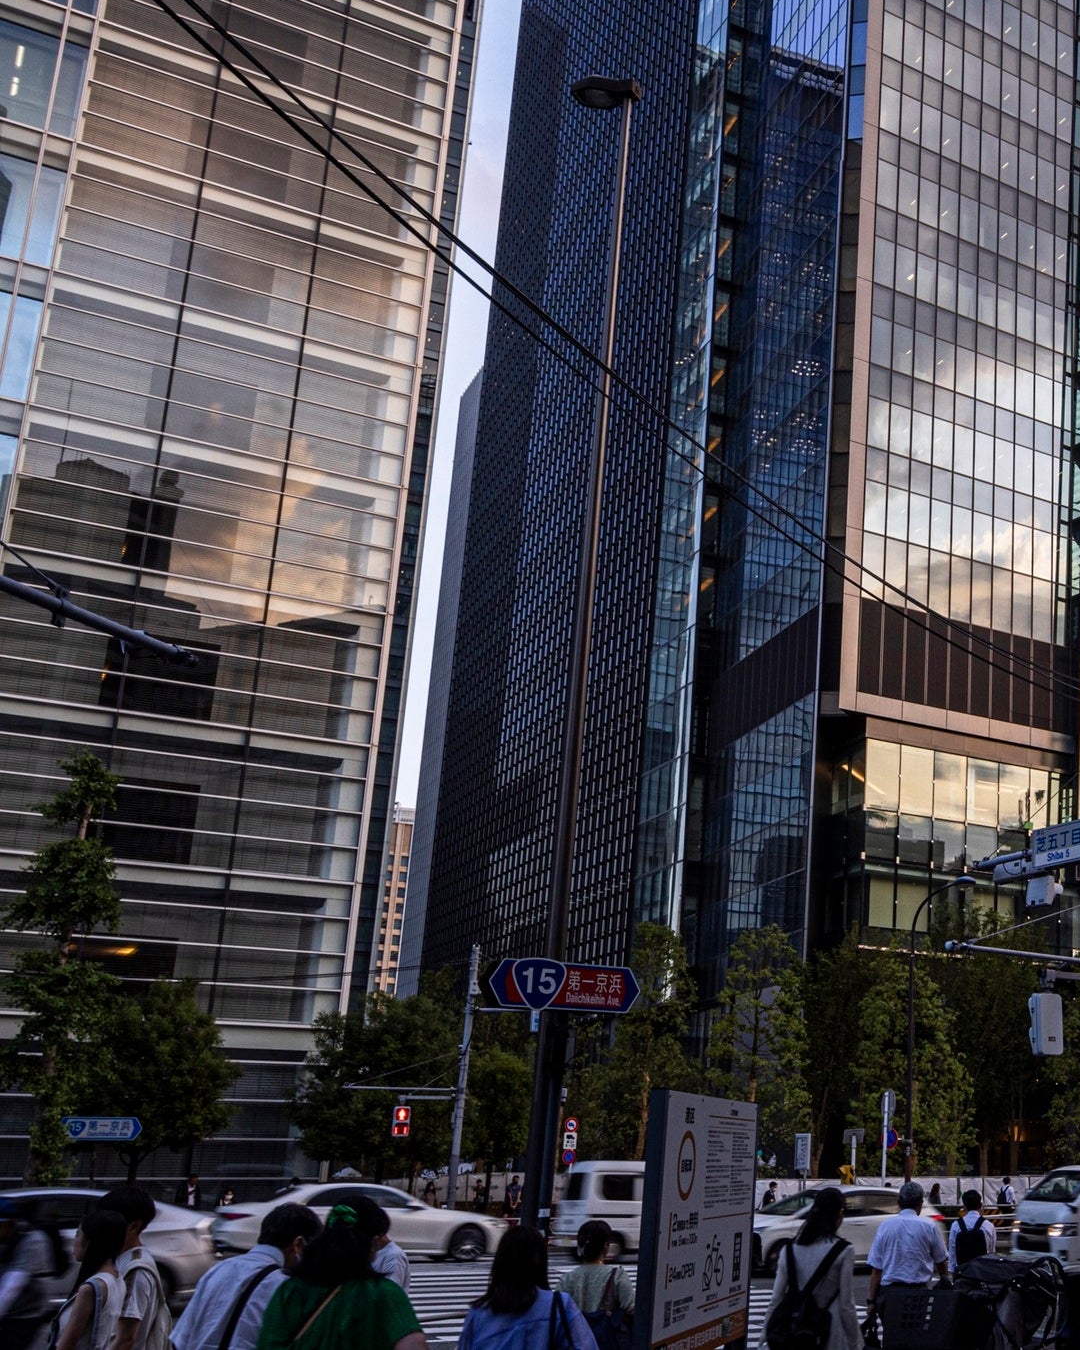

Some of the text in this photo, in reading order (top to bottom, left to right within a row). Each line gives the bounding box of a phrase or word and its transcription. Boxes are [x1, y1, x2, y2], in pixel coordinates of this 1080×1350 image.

[1047, 849, 1070, 862] Shiba 5
[522, 967, 557, 995] 15
[567, 970, 622, 995] 第一京浜
[565, 992, 621, 1007] Daiichikeihin Ave.
[71, 1123, 81, 1132] 15
